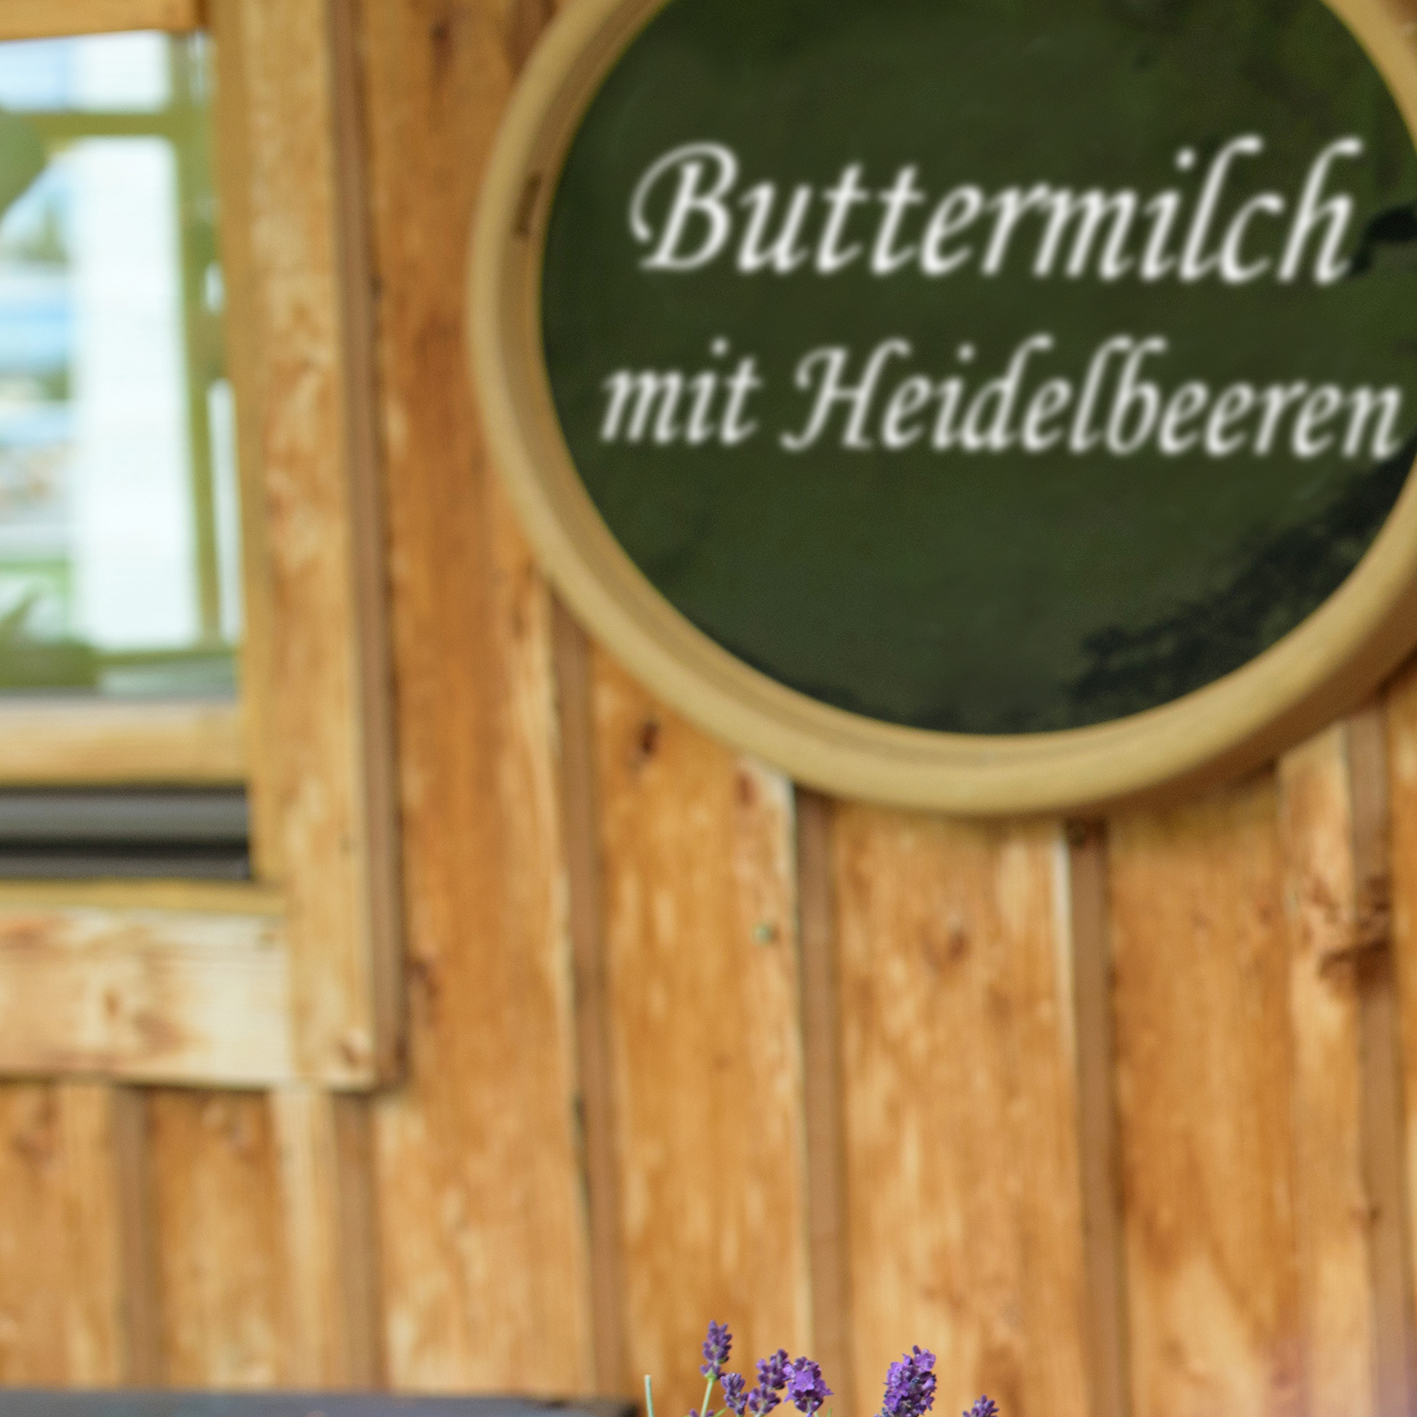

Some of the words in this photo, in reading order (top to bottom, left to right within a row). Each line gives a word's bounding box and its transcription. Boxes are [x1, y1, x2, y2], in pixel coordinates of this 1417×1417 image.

[630, 135, 1363, 285] Buttermilch
[602, 338, 761, 446] mit
[780, 334, 1402, 459] Heidelbeeren
